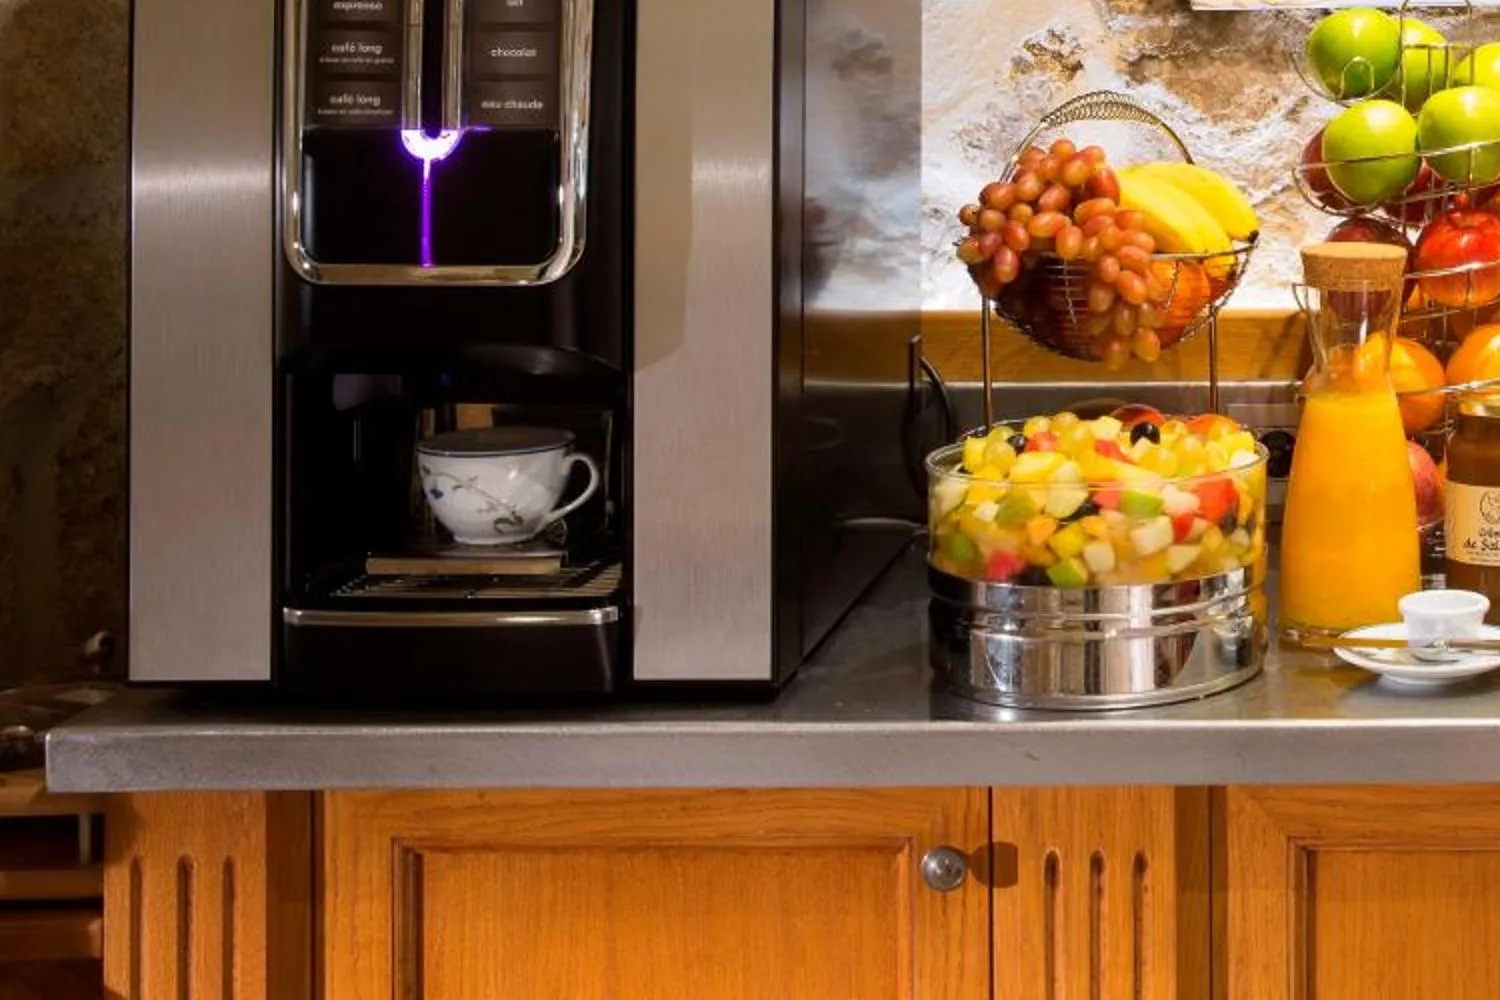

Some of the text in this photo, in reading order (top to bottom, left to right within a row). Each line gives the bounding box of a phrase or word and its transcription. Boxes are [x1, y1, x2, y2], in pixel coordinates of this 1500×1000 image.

[331, 41, 383, 55] café long
[491, 47, 538, 57] chocolat
[329, 93, 381, 107] café long
[481, 99, 544, 110] eau chaude
[1463, 537, 1477, 549] de
